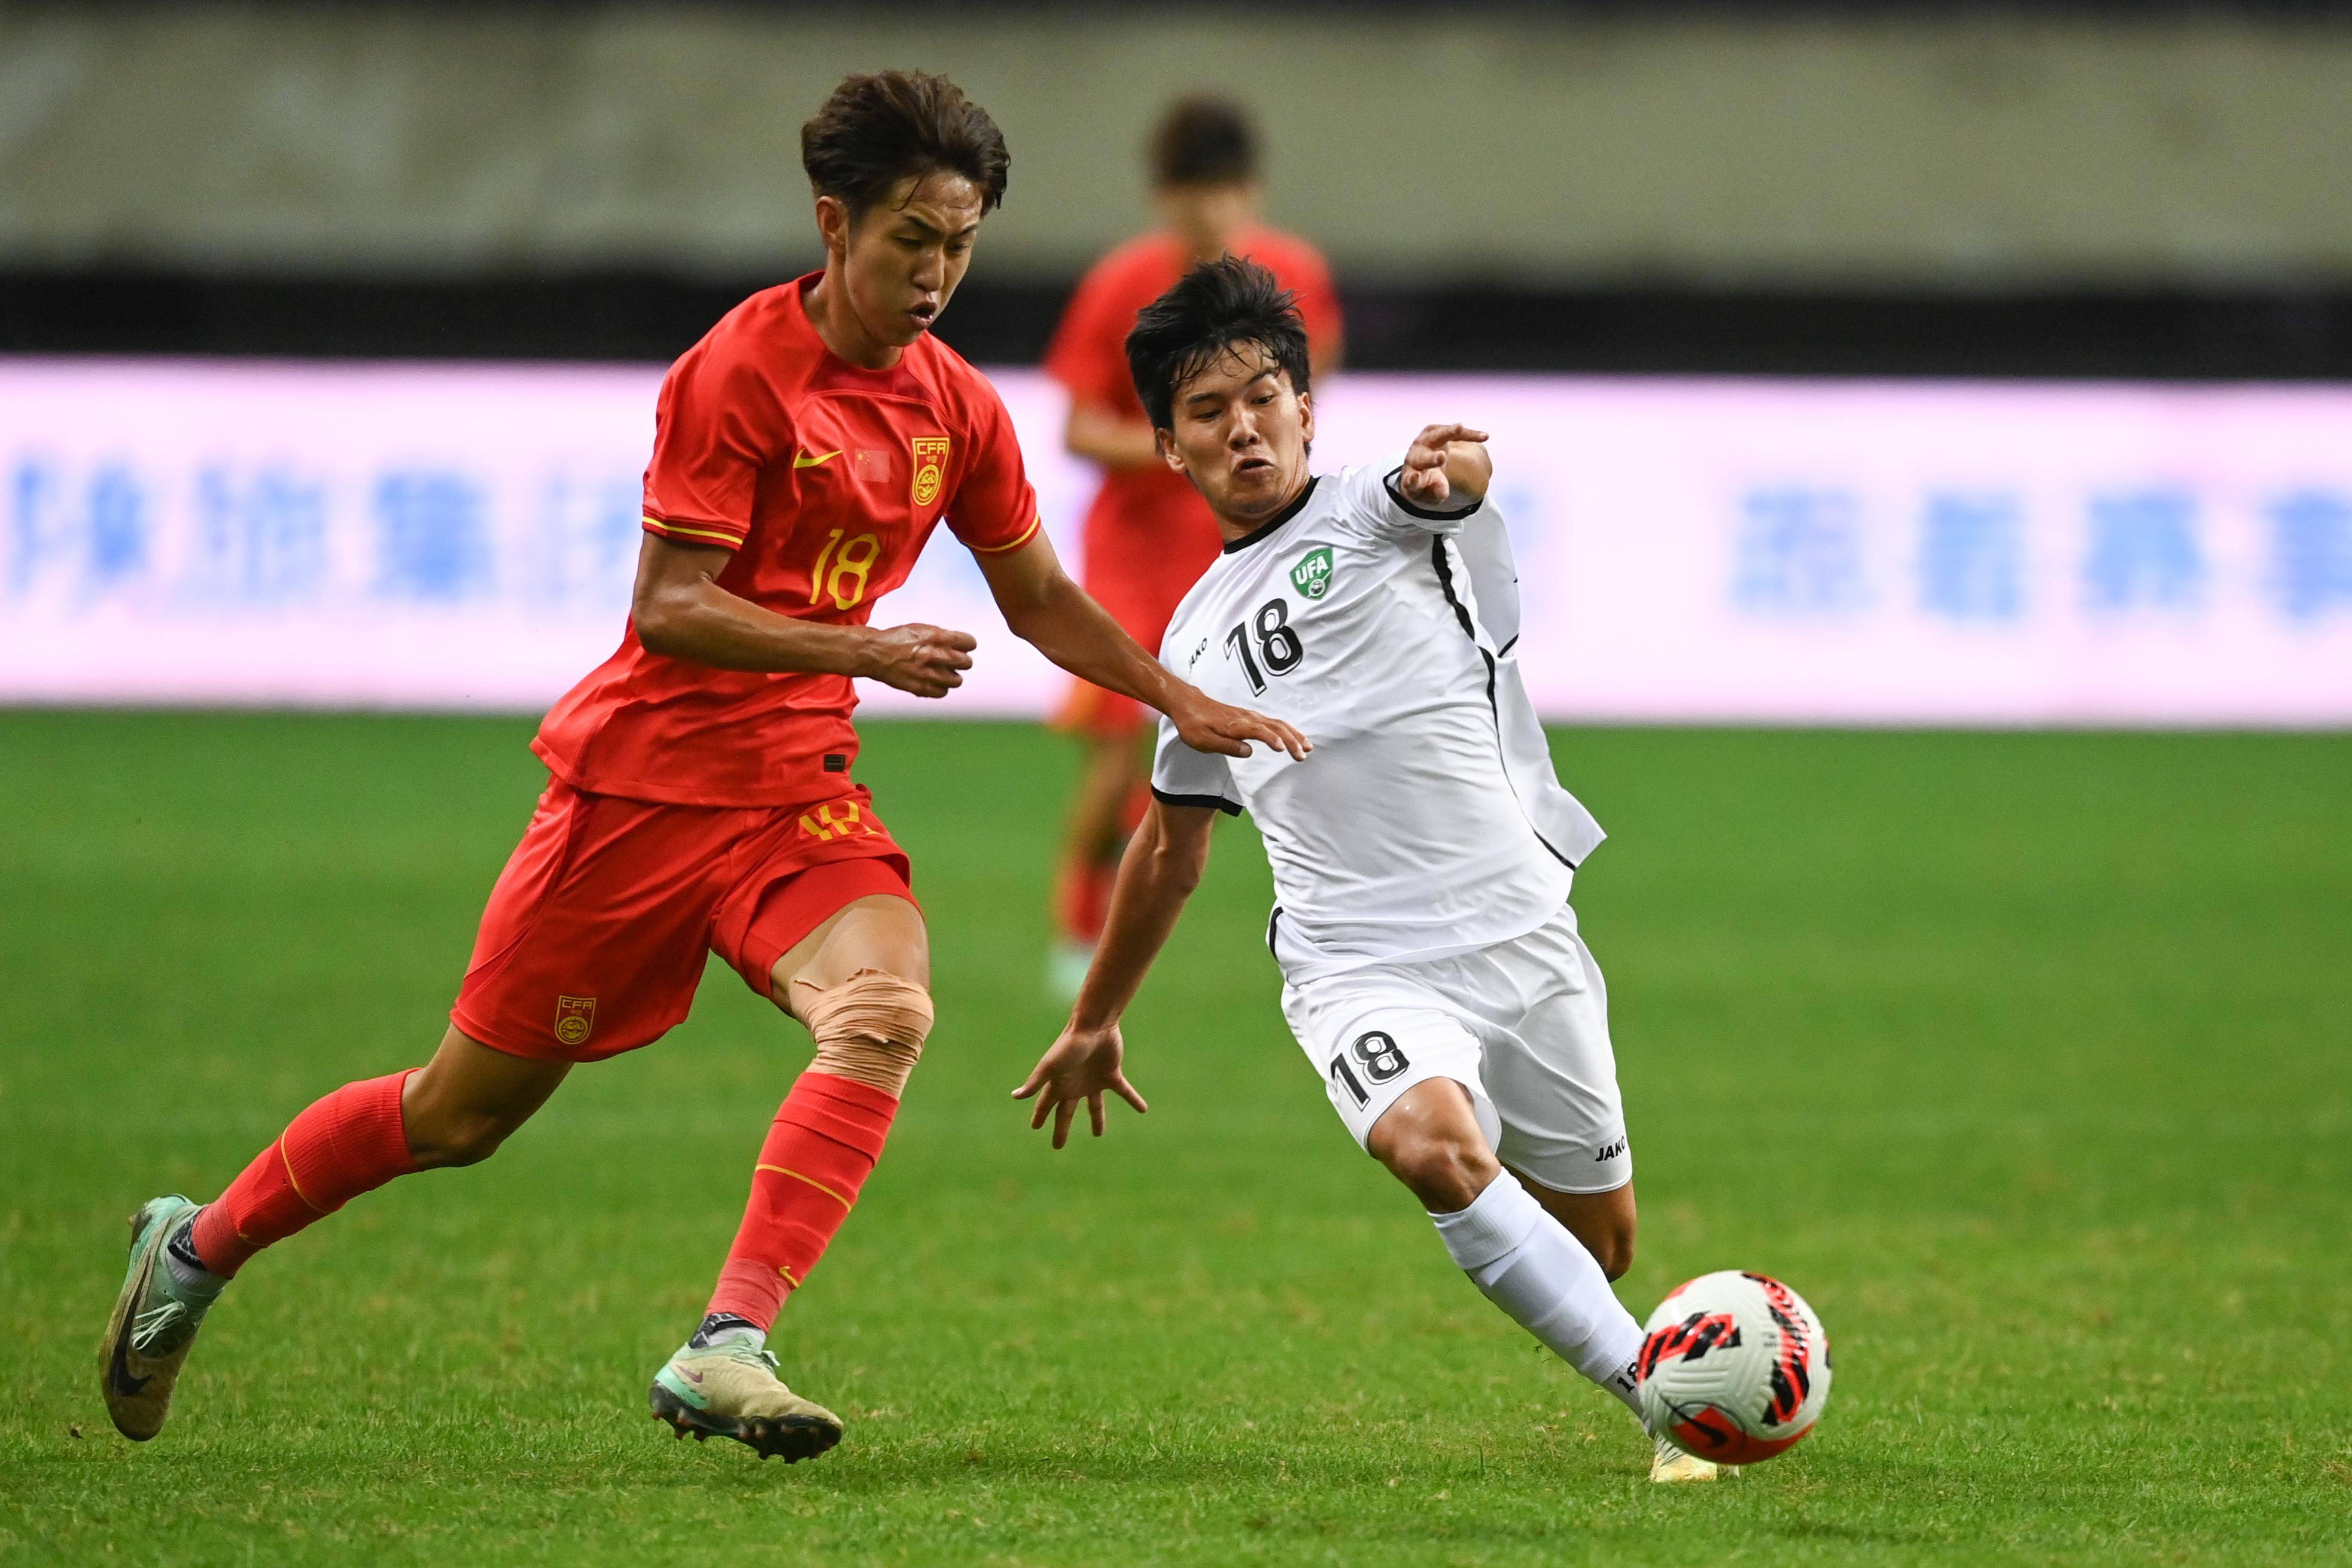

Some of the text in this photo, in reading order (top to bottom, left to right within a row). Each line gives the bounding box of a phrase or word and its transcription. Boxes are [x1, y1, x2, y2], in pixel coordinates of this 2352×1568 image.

[916, 443, 947, 455] CFA
[809, 528, 881, 610] 18
[1295, 555, 1329, 584] UFA
[1223, 598, 1303, 698] 18
[562, 999, 592, 1009] CFA
[1330, 1031, 1410, 1113] 18
[1595, 1135, 1625, 1162] JAKO
